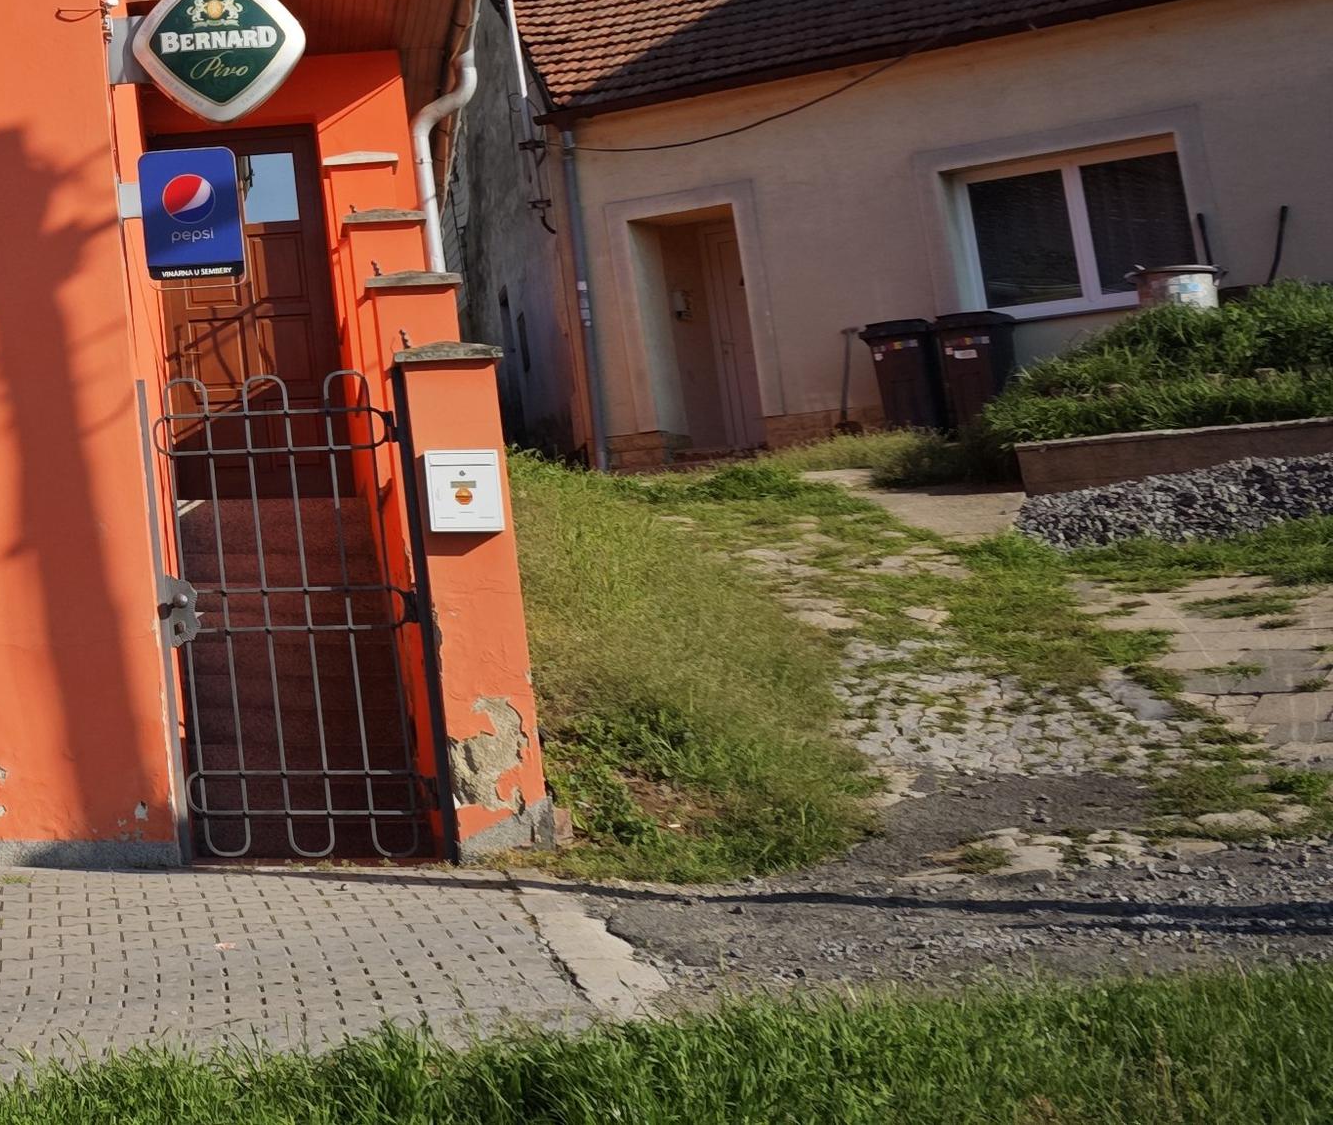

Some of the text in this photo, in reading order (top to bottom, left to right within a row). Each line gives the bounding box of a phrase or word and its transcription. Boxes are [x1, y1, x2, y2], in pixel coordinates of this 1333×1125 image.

[159, 26, 277, 54] BERNARD
[190, 51, 248, 79] Pivo
[171, 227, 213, 243] pepsi
